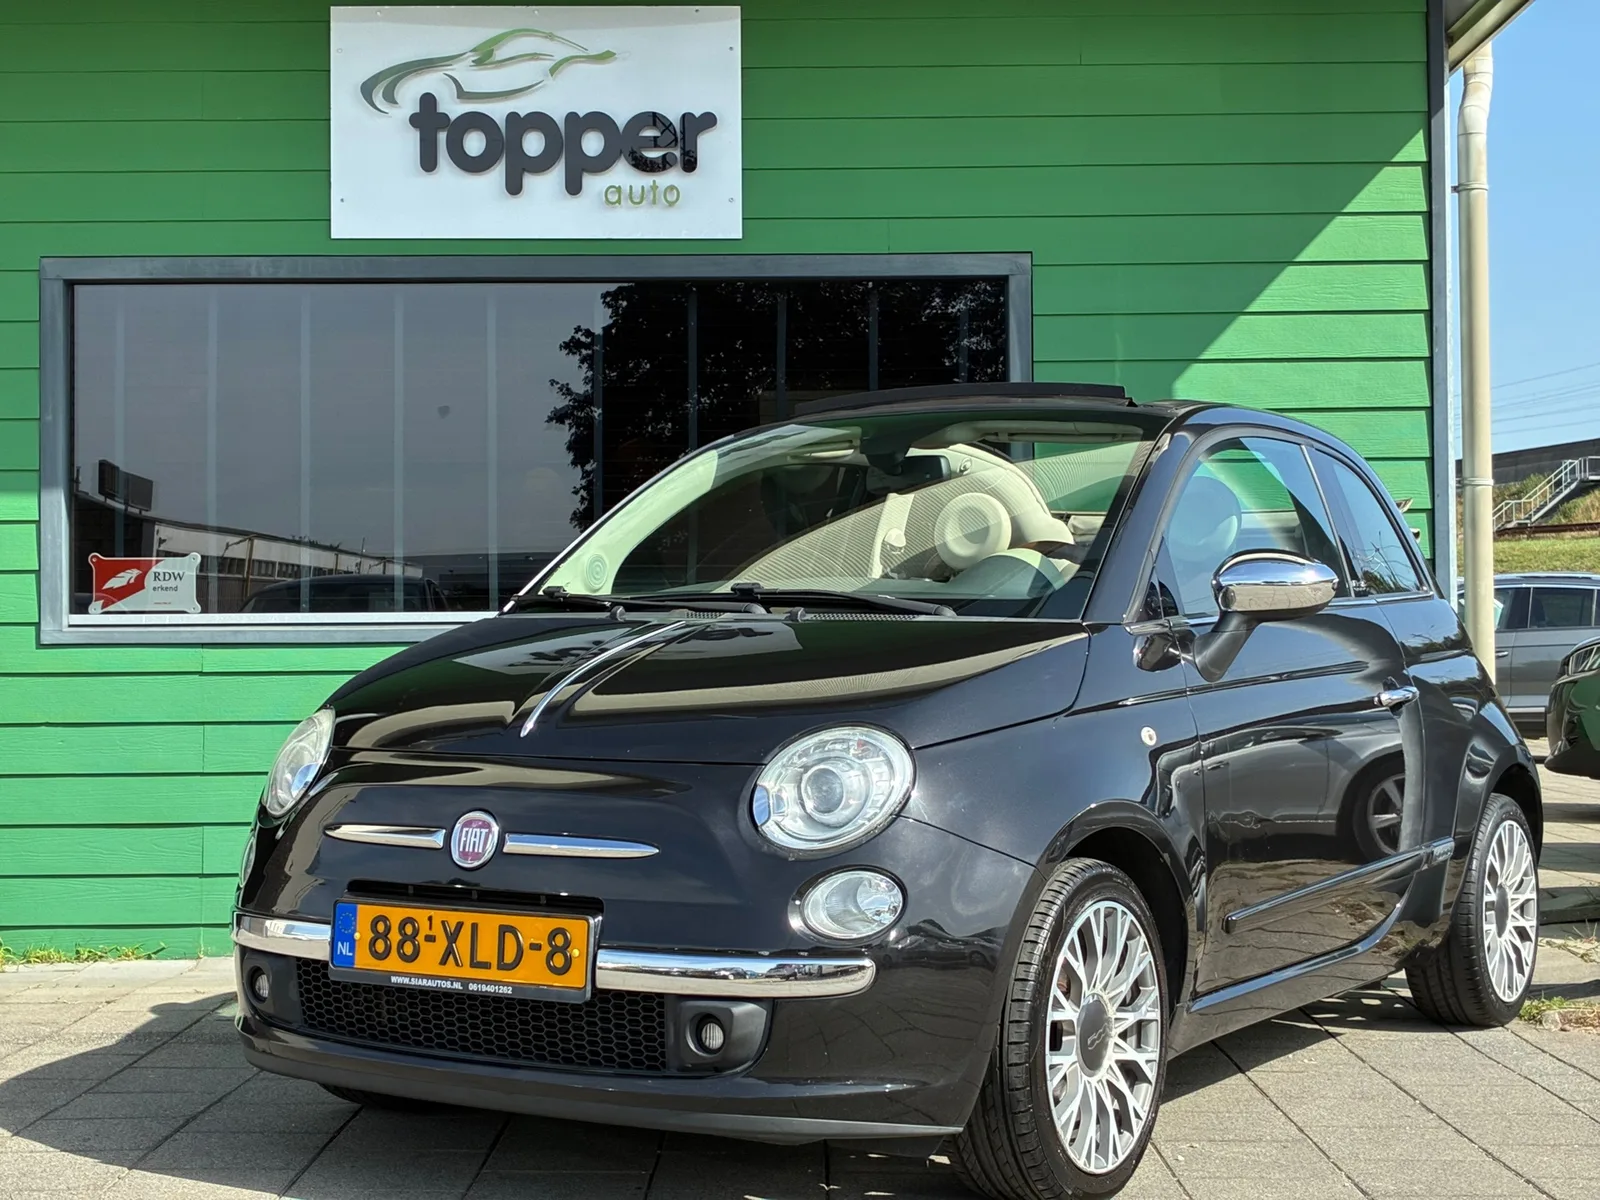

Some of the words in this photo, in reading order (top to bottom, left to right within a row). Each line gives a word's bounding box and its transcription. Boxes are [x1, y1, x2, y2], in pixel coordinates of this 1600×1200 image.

[408, 91, 718, 197] topper
[604, 179, 681, 207] auto
[153, 571, 185, 582] RDW
[459, 827, 490, 853] FIAT
[337, 941, 354, 956] NL
[368, 914, 573, 976] 88-XLD-8
[390, 975, 463, 990] WWW.SIARAUTOS.NL
[468, 982, 513, 994] 0619401262
